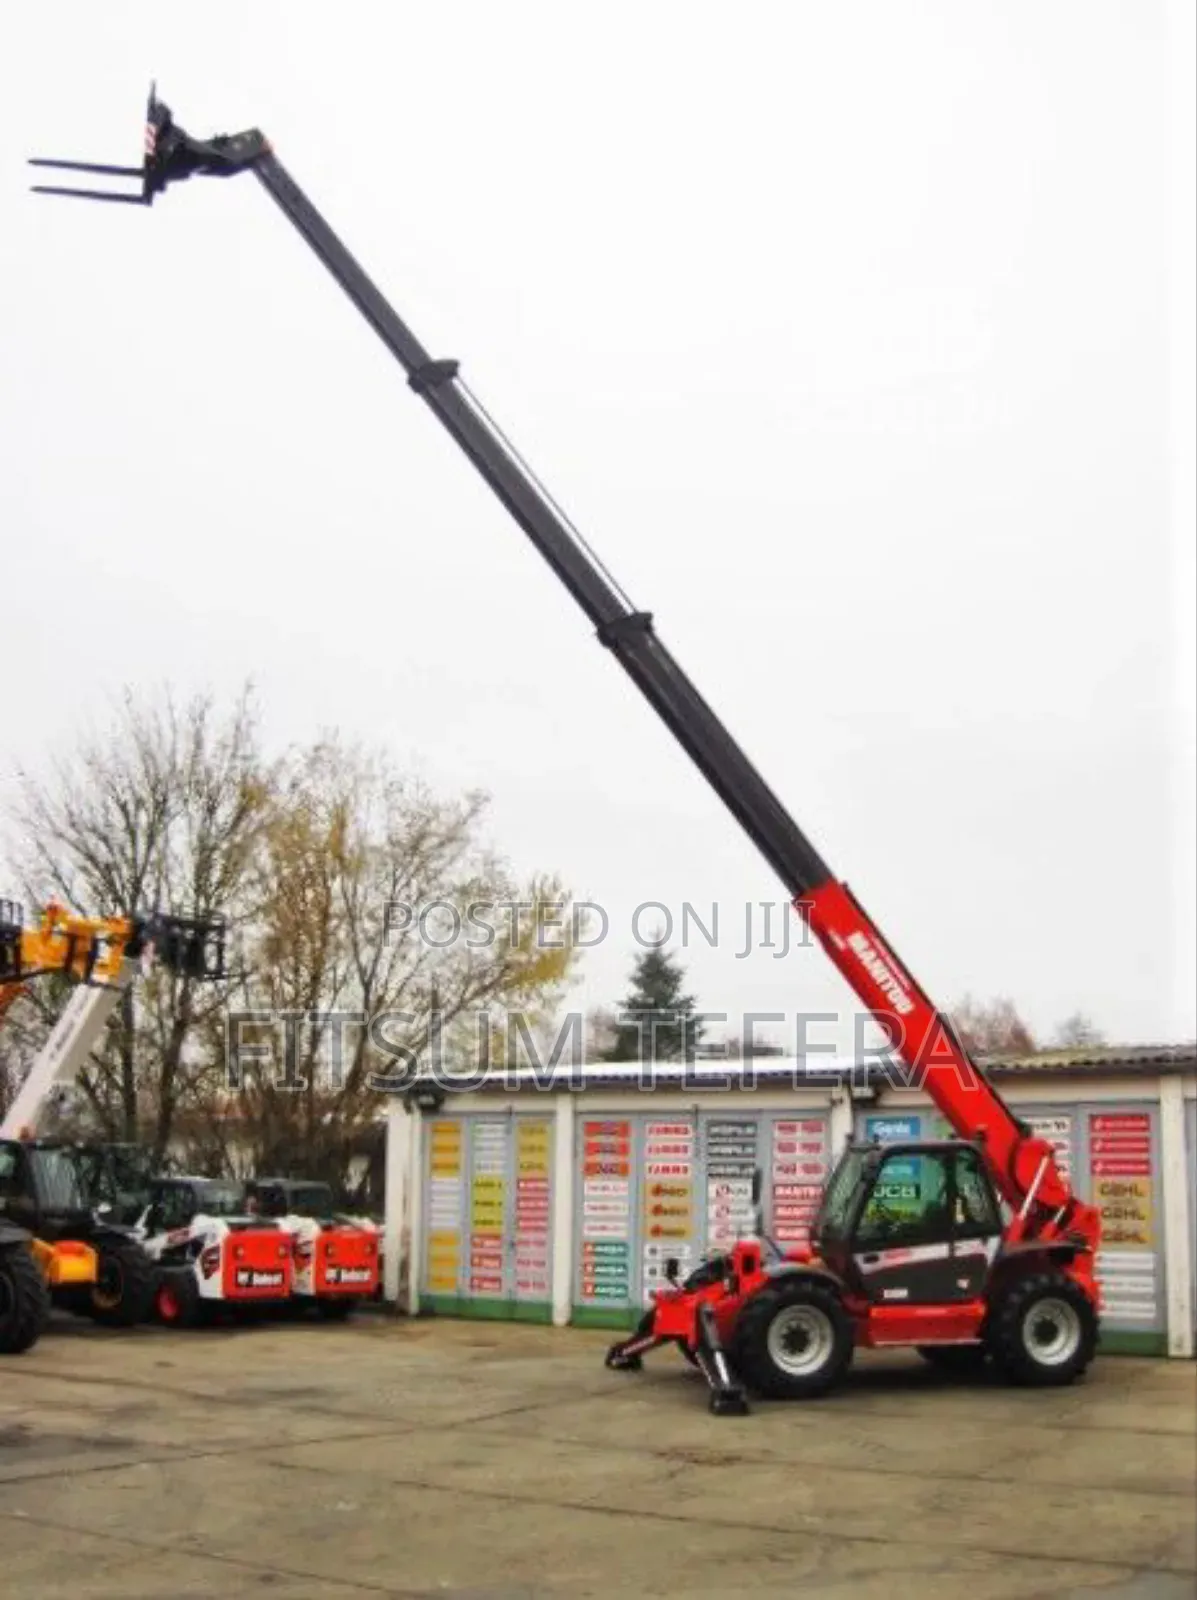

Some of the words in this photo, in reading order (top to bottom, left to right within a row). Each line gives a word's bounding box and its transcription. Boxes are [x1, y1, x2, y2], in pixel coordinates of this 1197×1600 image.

[846, 930, 916, 1015] MANITOU
[873, 1185, 916, 1198] JCB
[1099, 1183, 1145, 1197] GEHL
